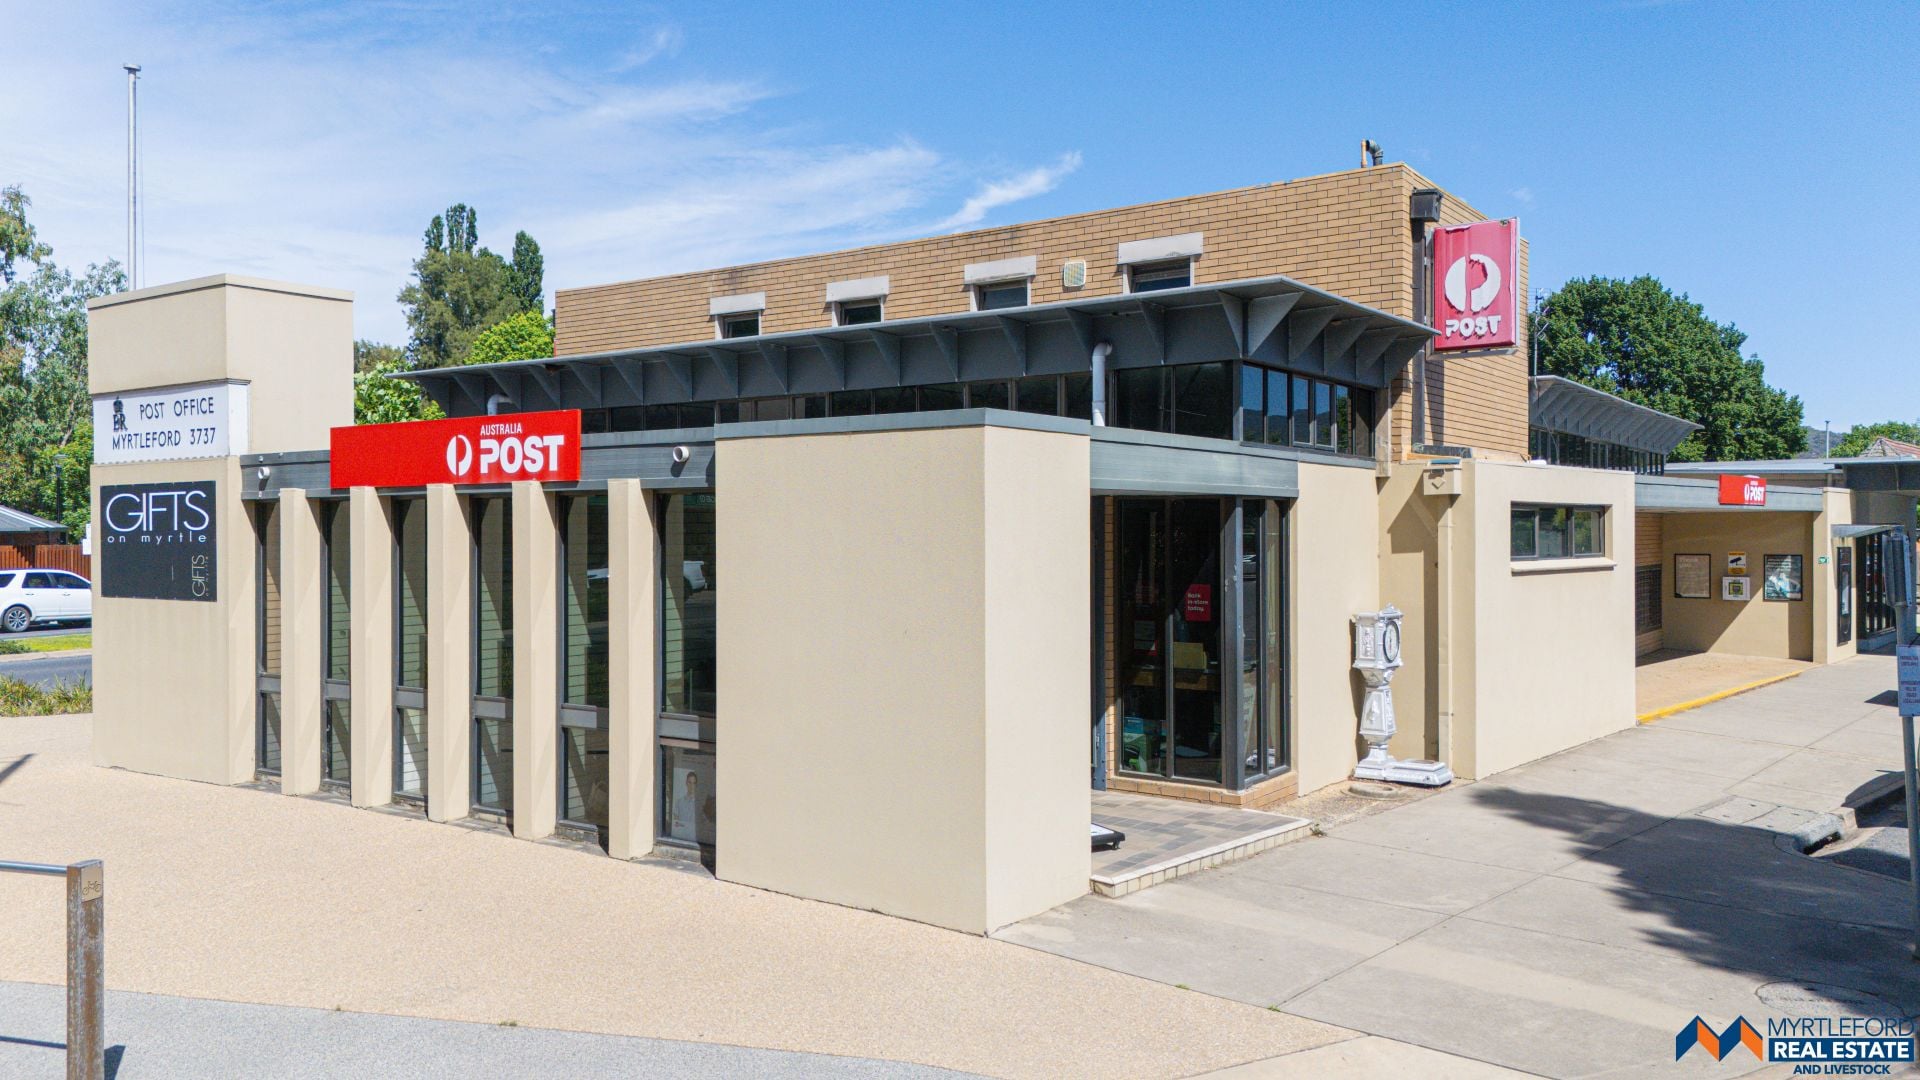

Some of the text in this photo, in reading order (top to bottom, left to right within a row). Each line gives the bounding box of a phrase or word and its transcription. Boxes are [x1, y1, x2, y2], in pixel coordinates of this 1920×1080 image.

[1445, 315, 1501, 338] POST
[140, 396, 215, 420] POST OFFICE
[112, 427, 216, 450] MYRTLEFORD 3737
[480, 422, 522, 435] AUSTRALIA
[480, 434, 565, 474] POST
[1750, 486, 1765, 501] POST
[105, 490, 210, 532] GIFTS
[107, 530, 207, 545] on myrtle
[191, 554, 206, 597] GIFTS
